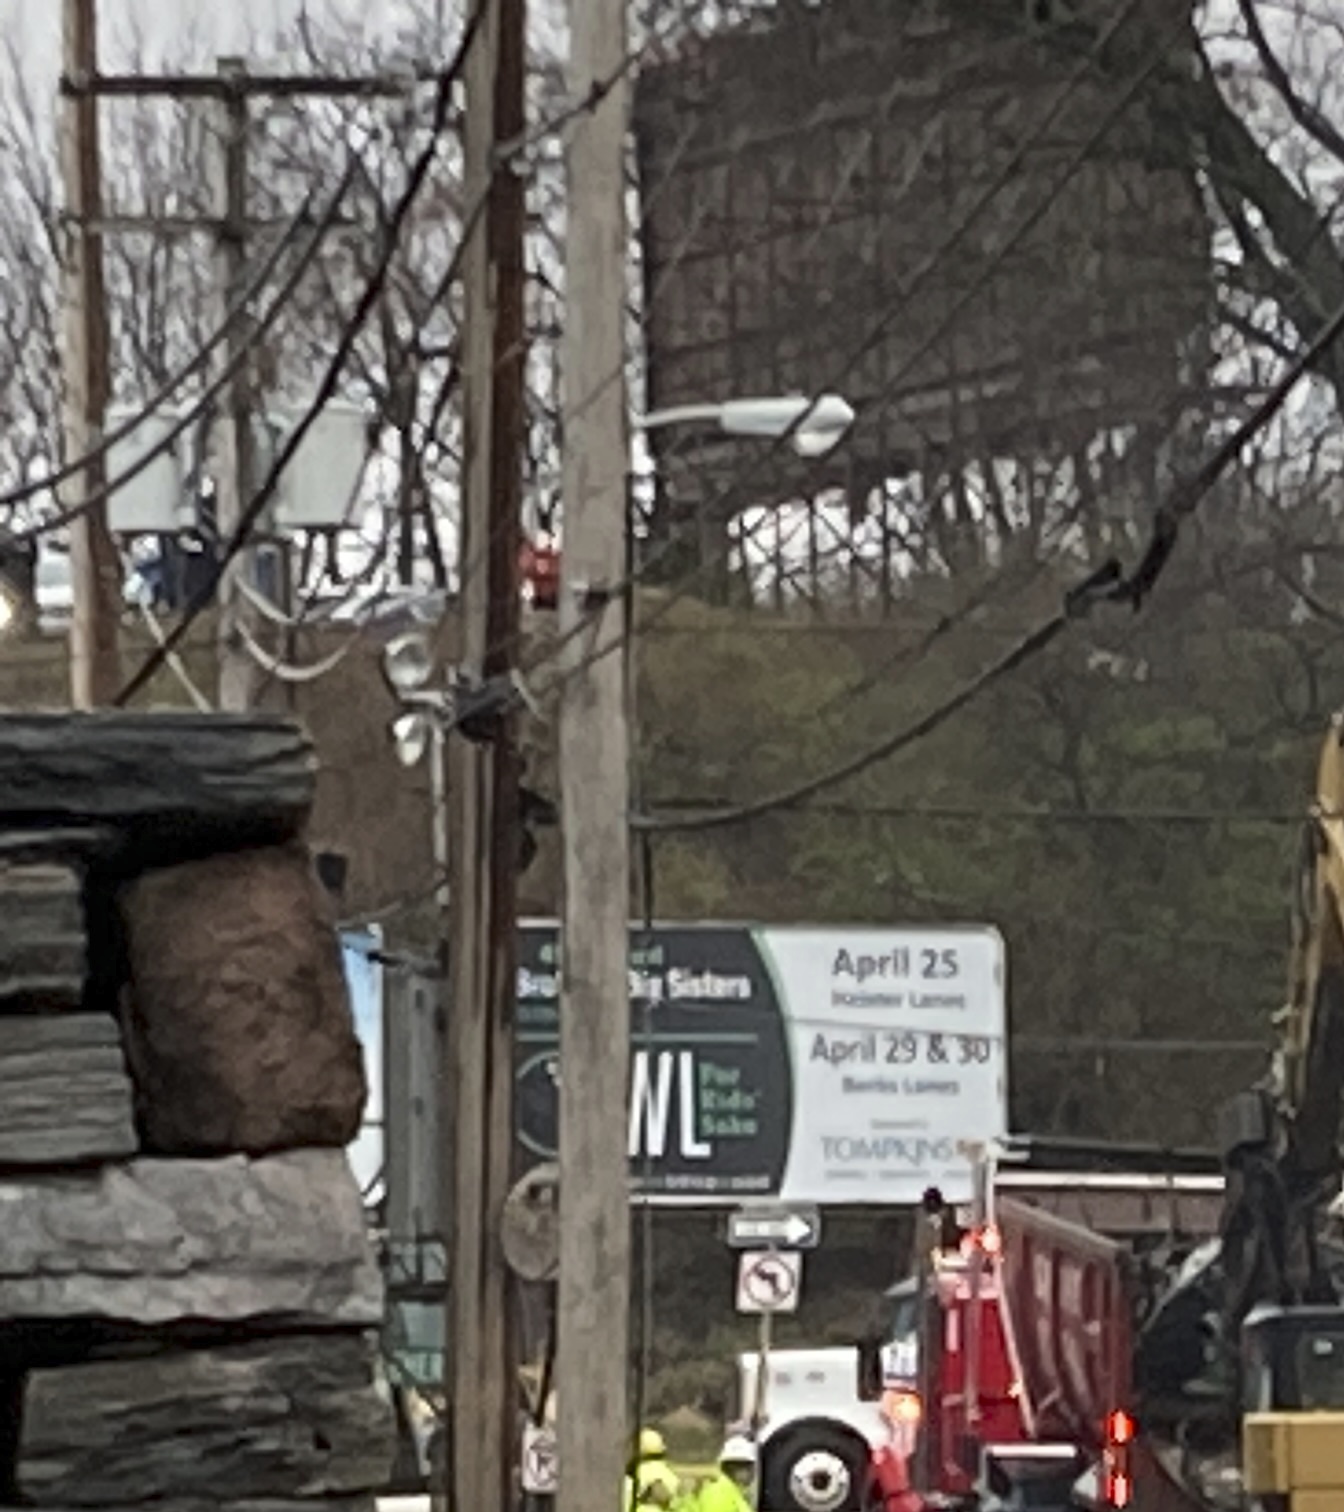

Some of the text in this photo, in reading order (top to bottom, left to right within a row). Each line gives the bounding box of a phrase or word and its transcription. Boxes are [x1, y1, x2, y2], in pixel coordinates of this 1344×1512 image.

[831, 947, 959, 982] April 25
[666, 967, 752, 998] Sisters
[809, 1033, 991, 1069] April 29 & 30
[820, 1136, 954, 1166] TOMPKINS
